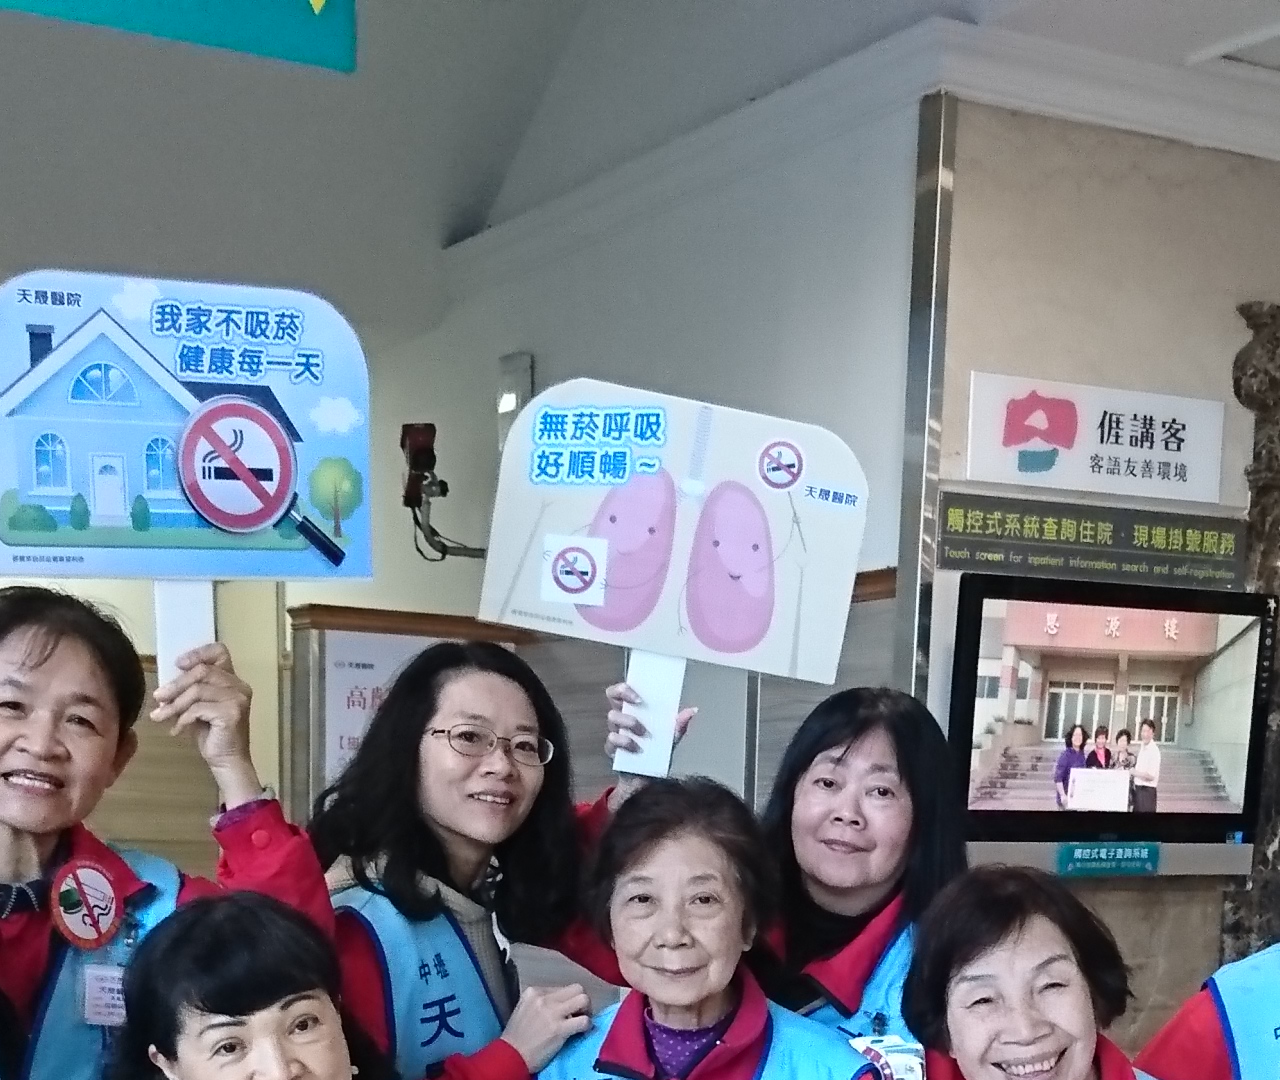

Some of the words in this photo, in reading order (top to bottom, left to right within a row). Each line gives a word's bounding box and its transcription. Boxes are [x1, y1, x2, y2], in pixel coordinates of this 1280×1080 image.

[17, 288, 82, 307] 天晟醫院
[155, 304, 302, 342] 我家不吸菸
[178, 344, 322, 382] 健康每一天
[539, 410, 662, 443] 無菸呼吸
[1089, 453, 1189, 483] 客語友善環境
[805, 485, 858, 508] 天晟醫院
[945, 546, 970, 559] Touch
[975, 551, 1004, 562] screen
[1009, 552, 1021, 563] for
[1028, 554, 1064, 567] inpatient
[1070, 556, 1117, 571] information
[1122, 561, 1149, 573] search
[1153, 562, 1168, 574] and
[420, 952, 449, 985] 中壢
